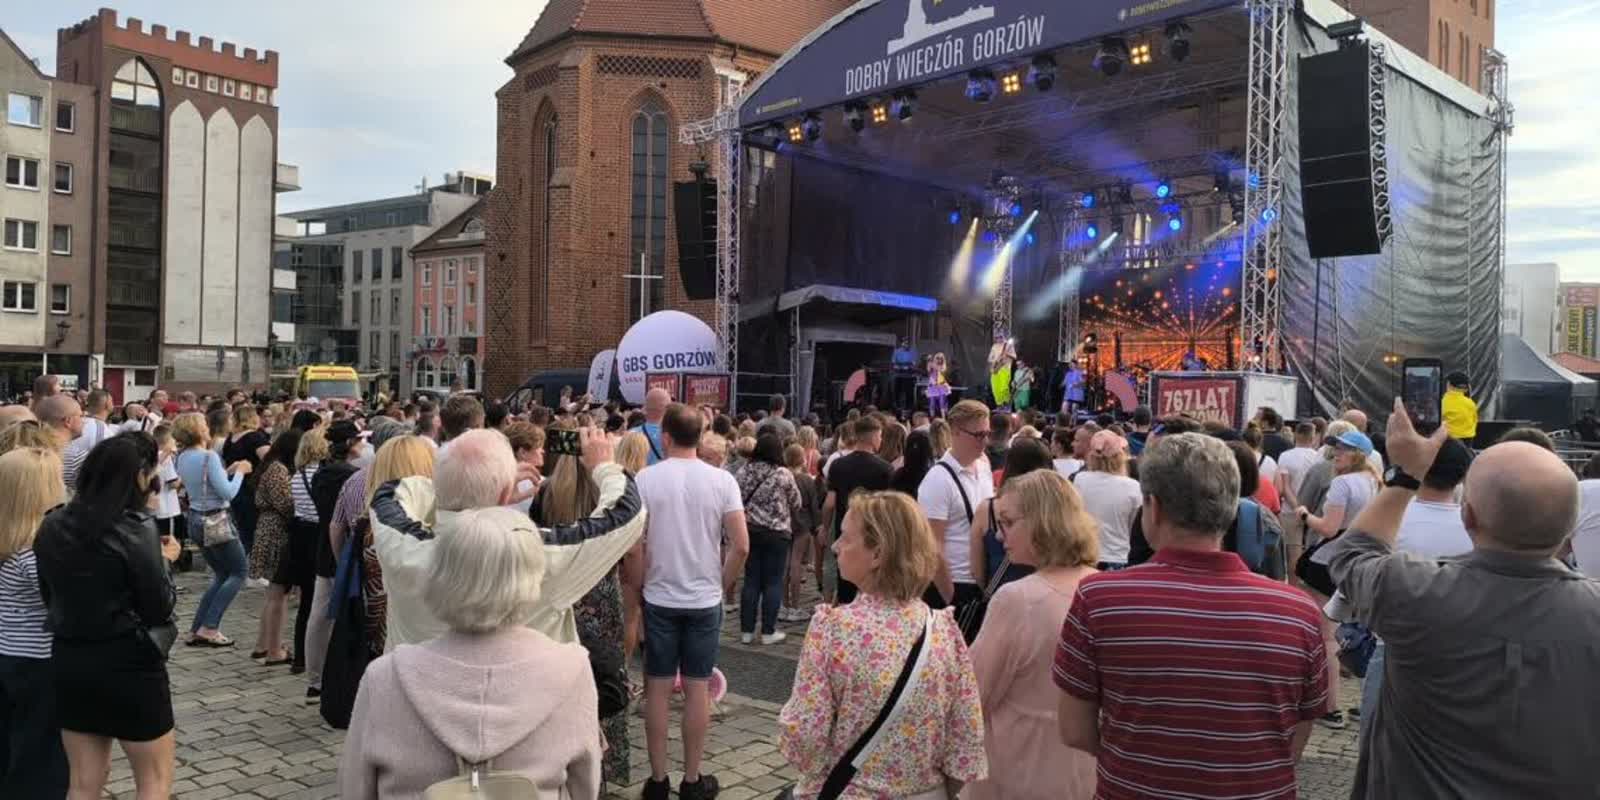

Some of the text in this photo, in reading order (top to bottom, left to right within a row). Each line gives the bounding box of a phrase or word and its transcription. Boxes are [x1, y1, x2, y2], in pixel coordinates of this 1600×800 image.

[845, 14, 1045, 96] DOBRY WIECZÓR GORZÓW
[622, 355, 648, 374] GBS
[652, 347, 716, 370] GORZÓW
[1163, 386, 1230, 412] 767 LAT
